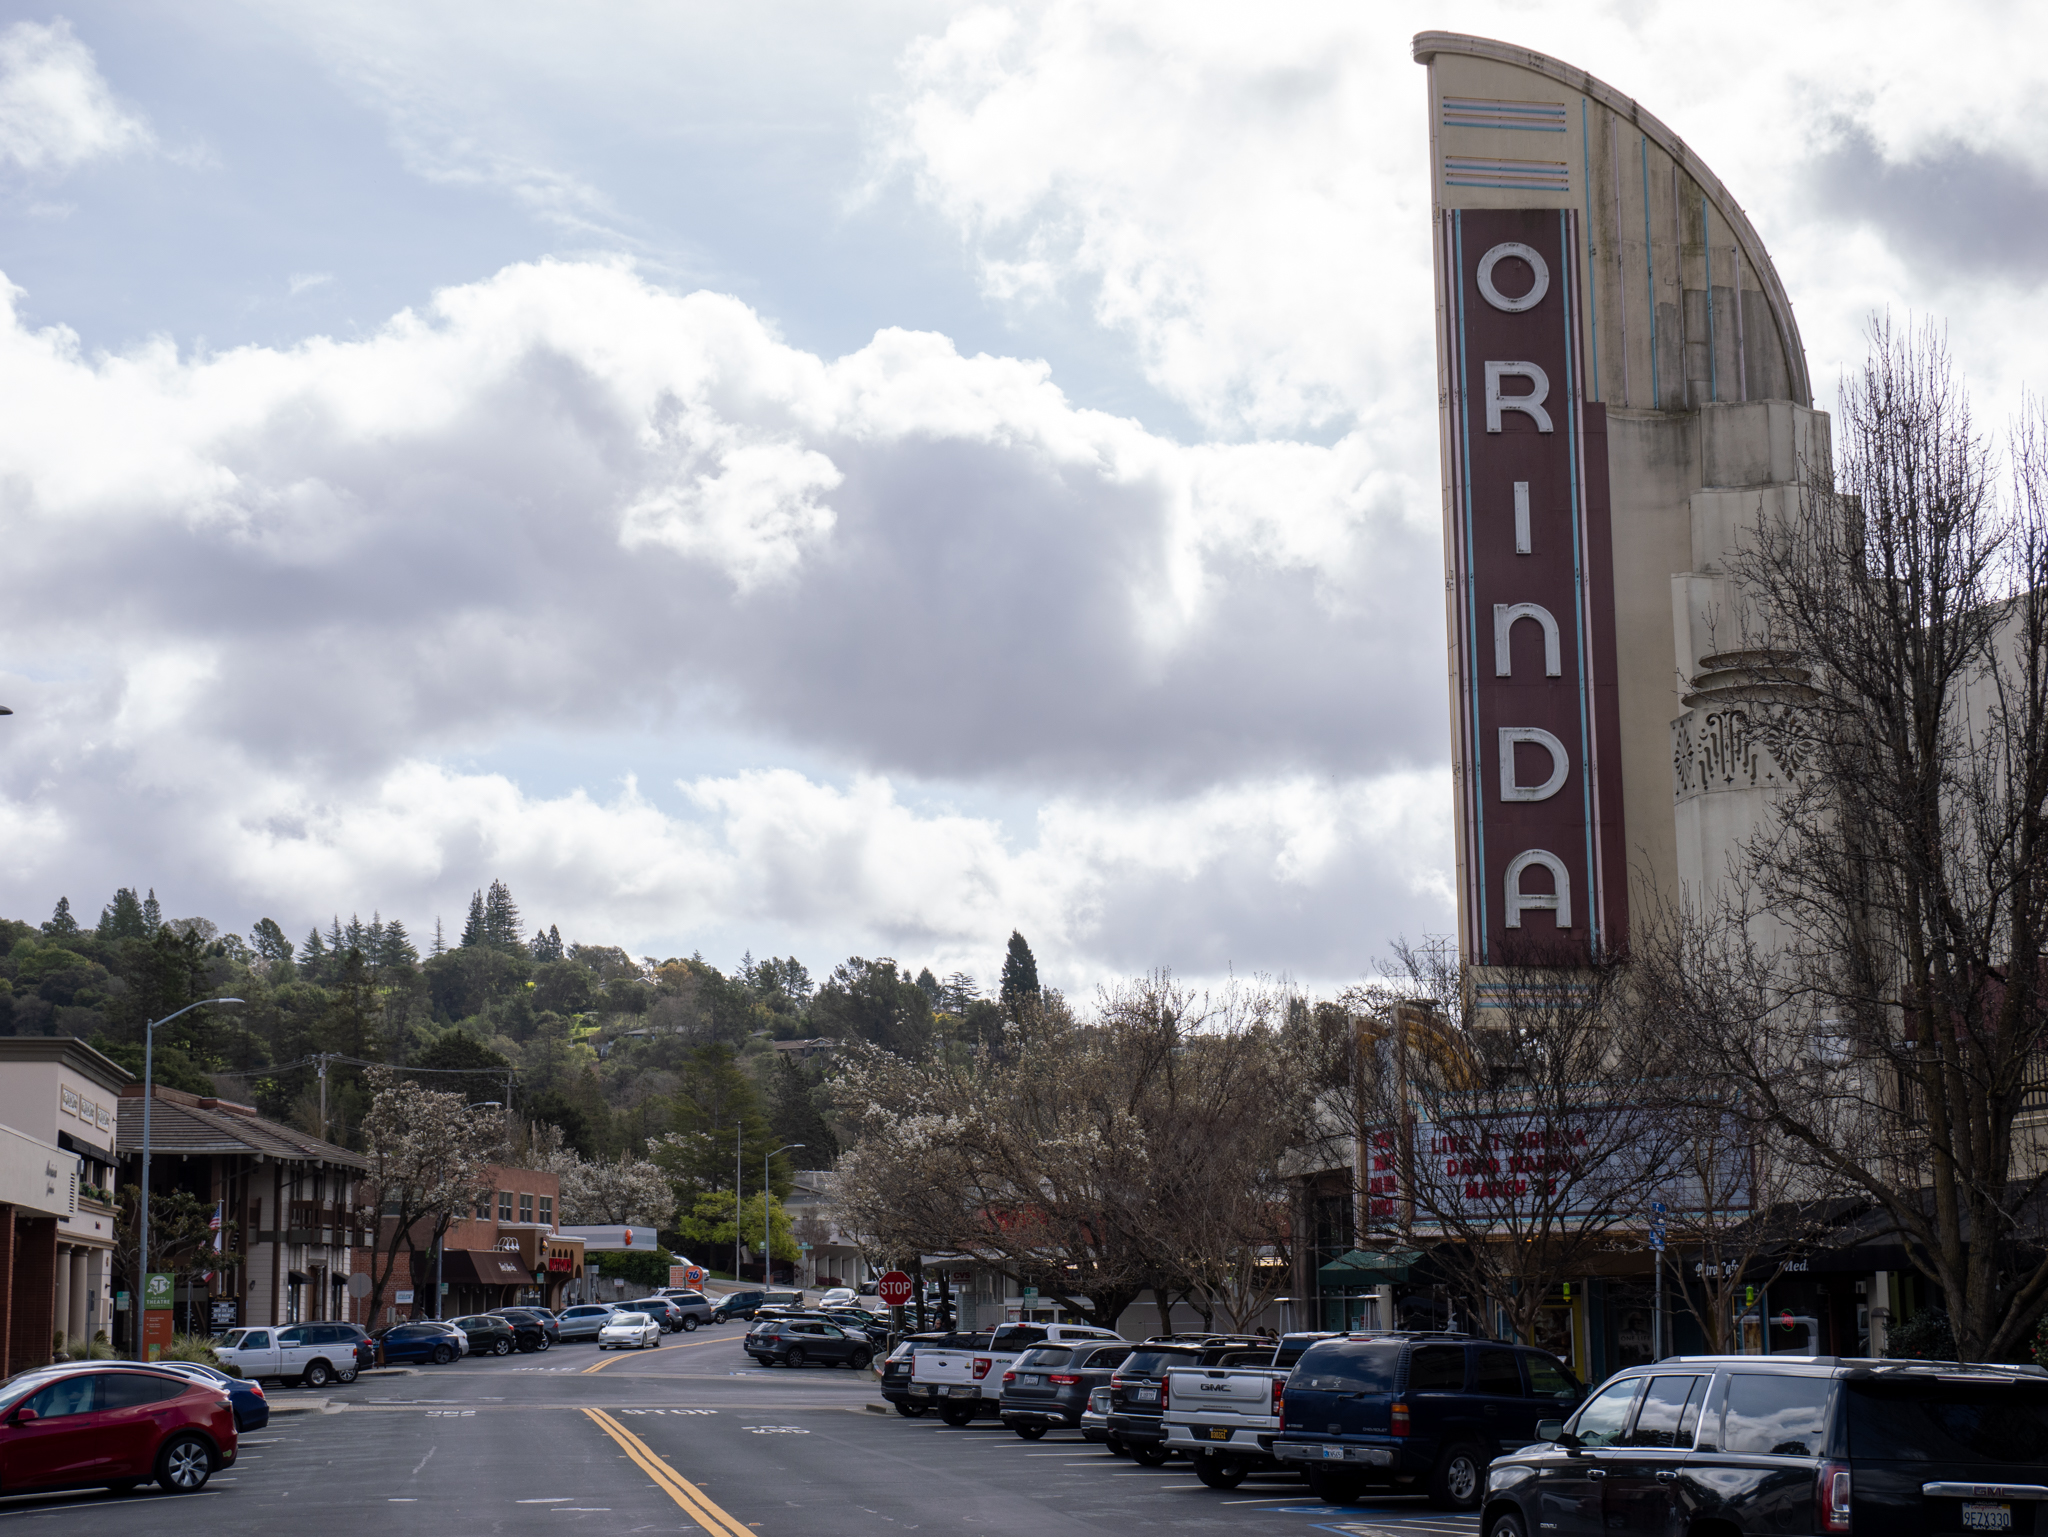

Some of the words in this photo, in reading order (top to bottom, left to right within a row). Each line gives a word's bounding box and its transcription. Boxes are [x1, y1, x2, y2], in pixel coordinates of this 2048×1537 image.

[1431, 1135, 1470, 1154] LIVE
[1480, 1133, 1501, 1151] AT
[1465, 1179, 1526, 1198] MARCH
[688, 1270, 699, 1279] 76
[953, 1271, 971, 1279] CVS
[1695, 1262, 1718, 1277] Ptra
[880, 1282, 911, 1295] STOP
[1200, 1383, 1231, 1392] GMC
[1973, 1486, 2014, 1497] GMC
[1964, 1512, 2009, 1527] 9EZX330
